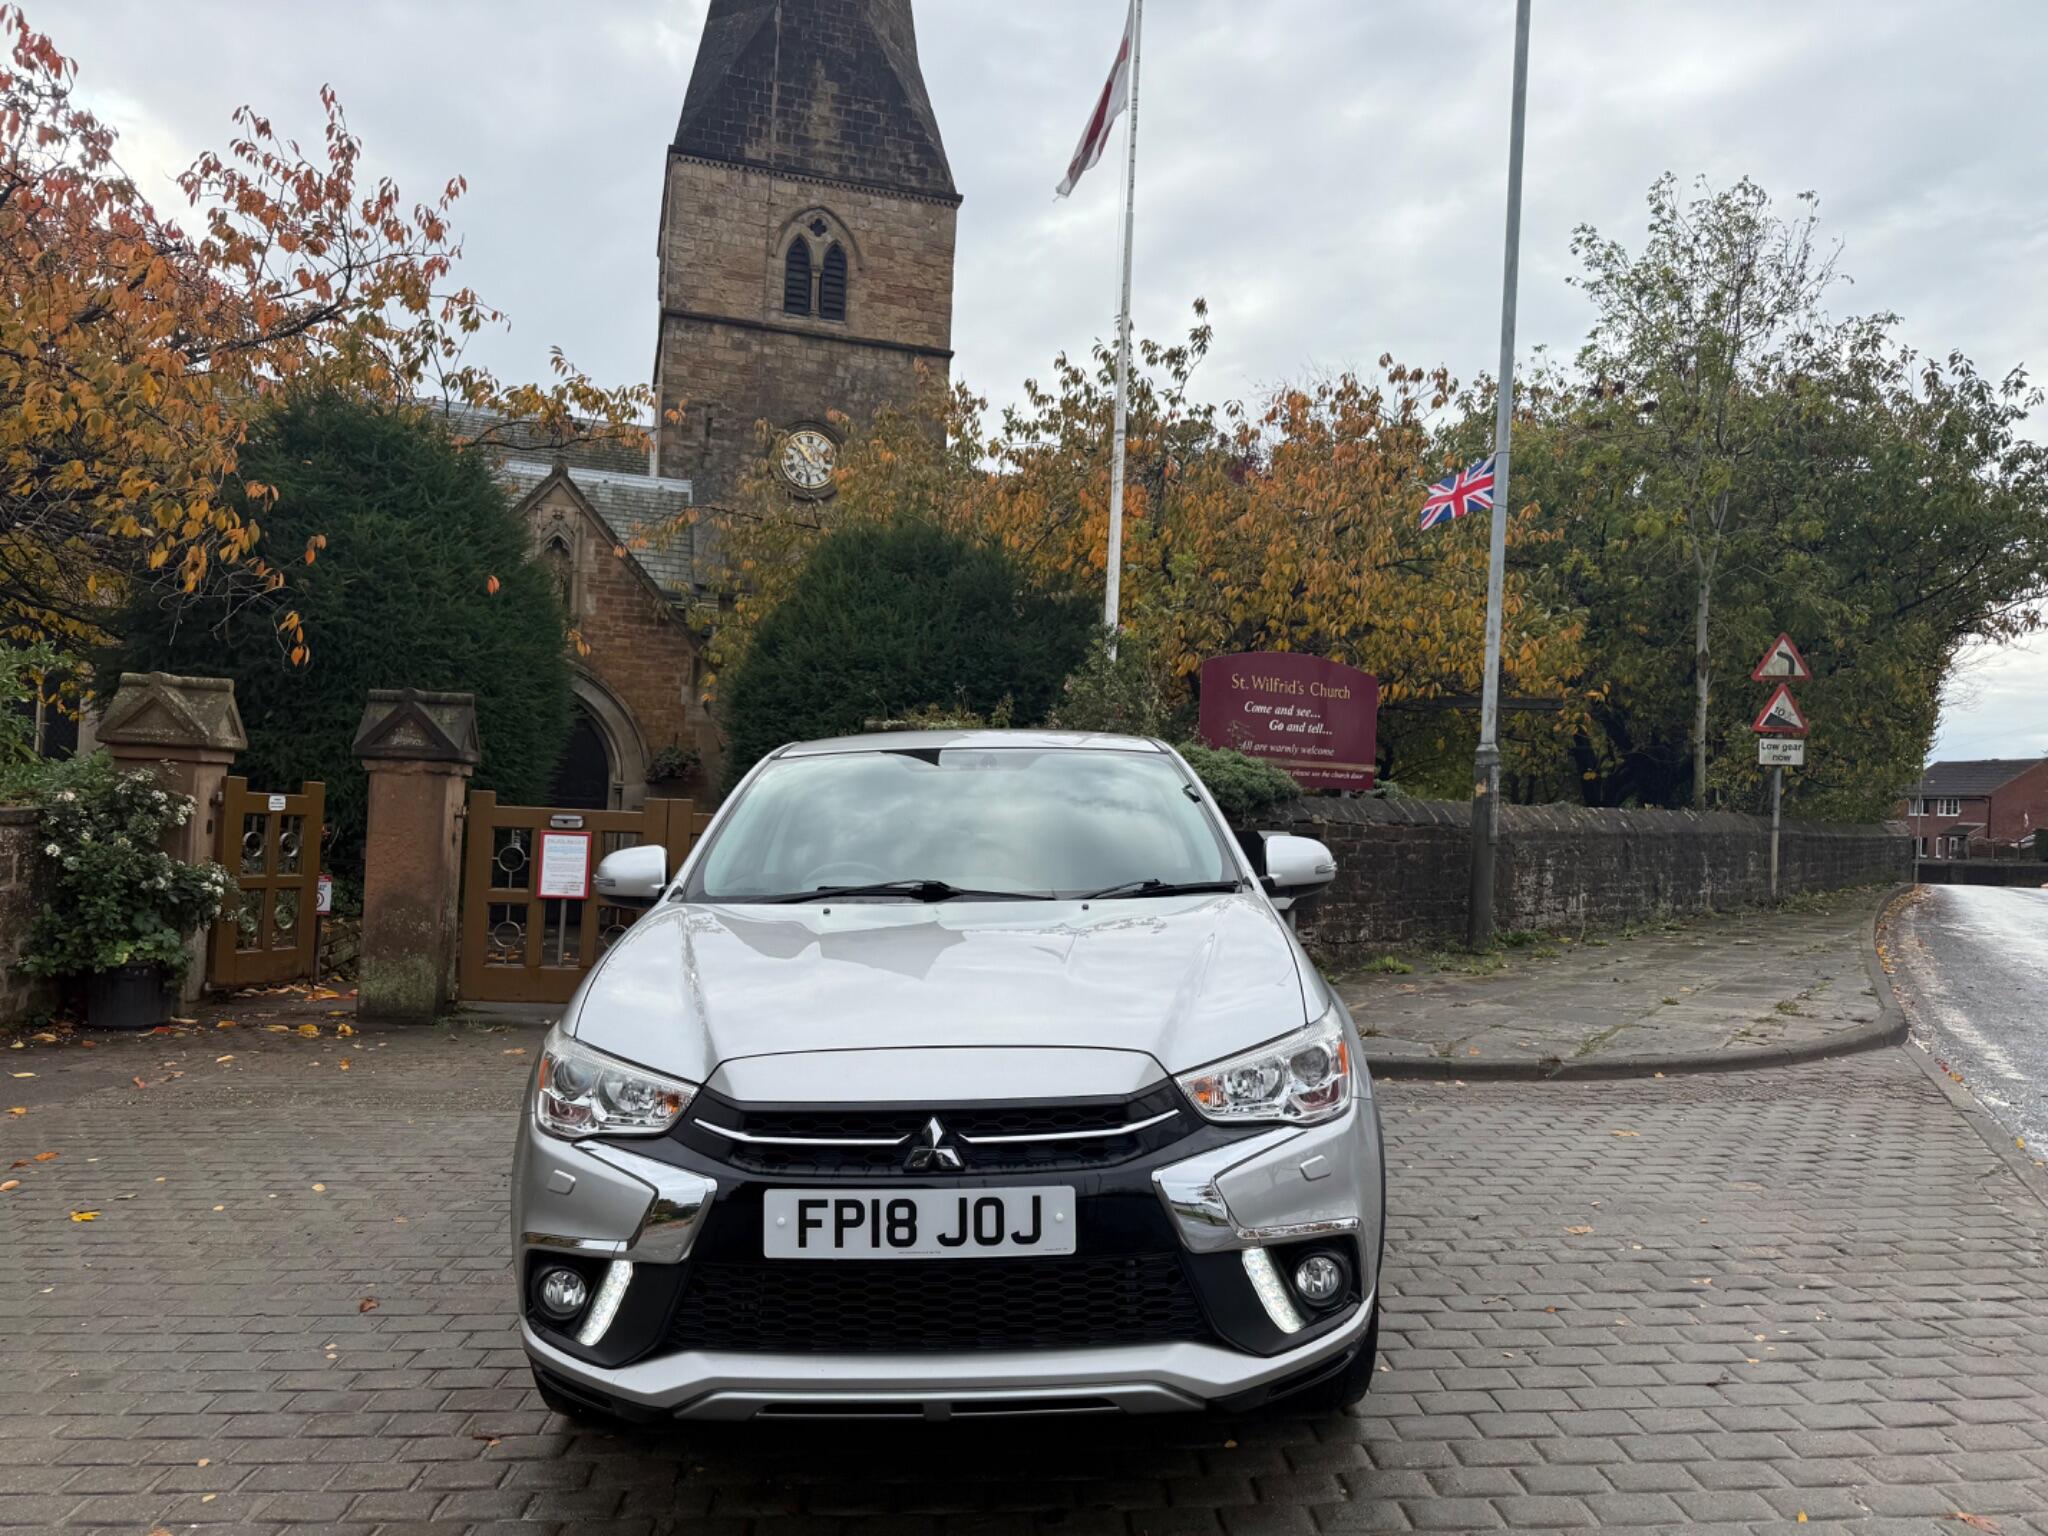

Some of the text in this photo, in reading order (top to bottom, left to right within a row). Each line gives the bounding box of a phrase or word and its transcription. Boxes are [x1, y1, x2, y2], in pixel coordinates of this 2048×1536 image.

[1231, 673, 1351, 699] St. Wilfrid's Church
[1244, 700, 1321, 718] Come and see...
[1269, 719, 1333, 735] Go and tell...
[1254, 743, 1268, 752] are
[1270, 743, 1299, 756] warmly
[1301, 745, 1335, 757] welcome
[1761, 741, 1802, 752] Low gear
[798, 1195, 1042, 1249] FP18 JOJ
